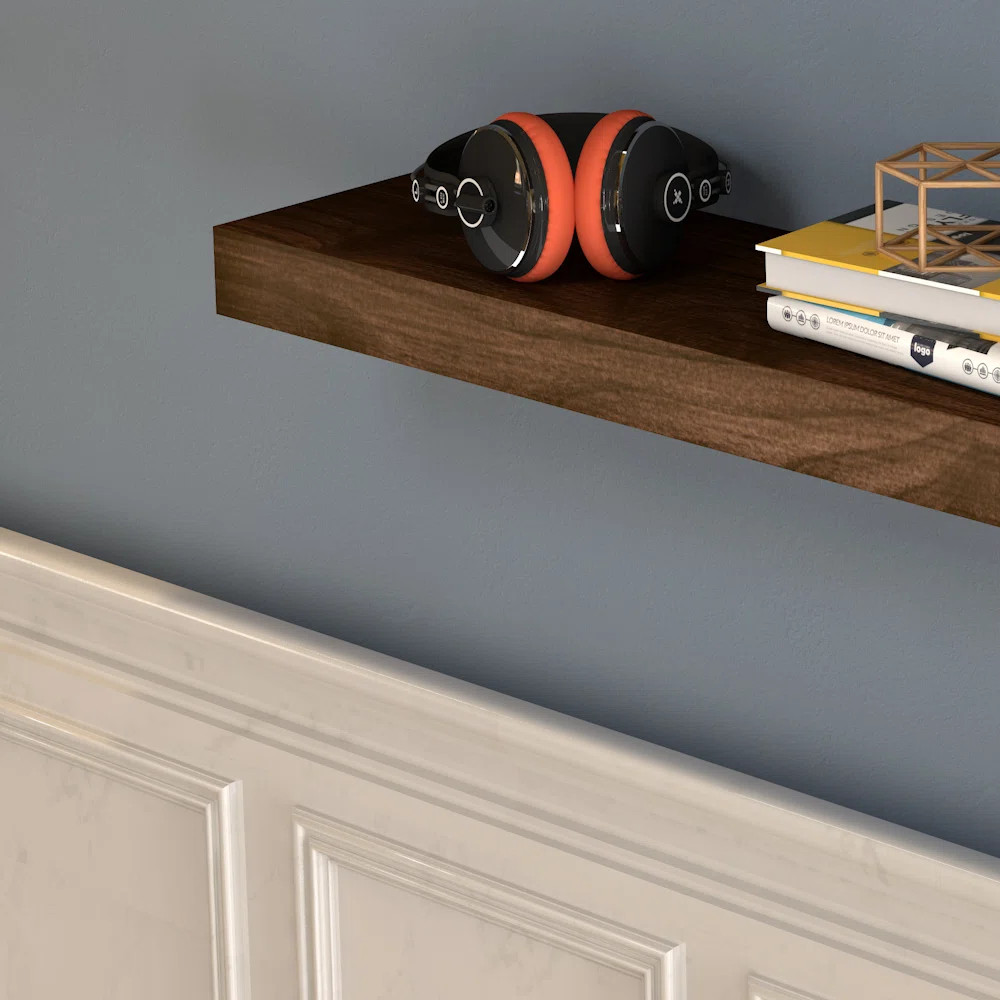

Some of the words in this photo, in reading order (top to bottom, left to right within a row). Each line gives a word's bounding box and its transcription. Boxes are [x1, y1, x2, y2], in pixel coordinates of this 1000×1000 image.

[826, 316, 844, 326] LOREM
[844, 320, 859, 331] IPSUM
[859, 325, 878, 336] DOLOR
[886, 334, 900, 343] AMET
[913, 342, 931, 356] logo
